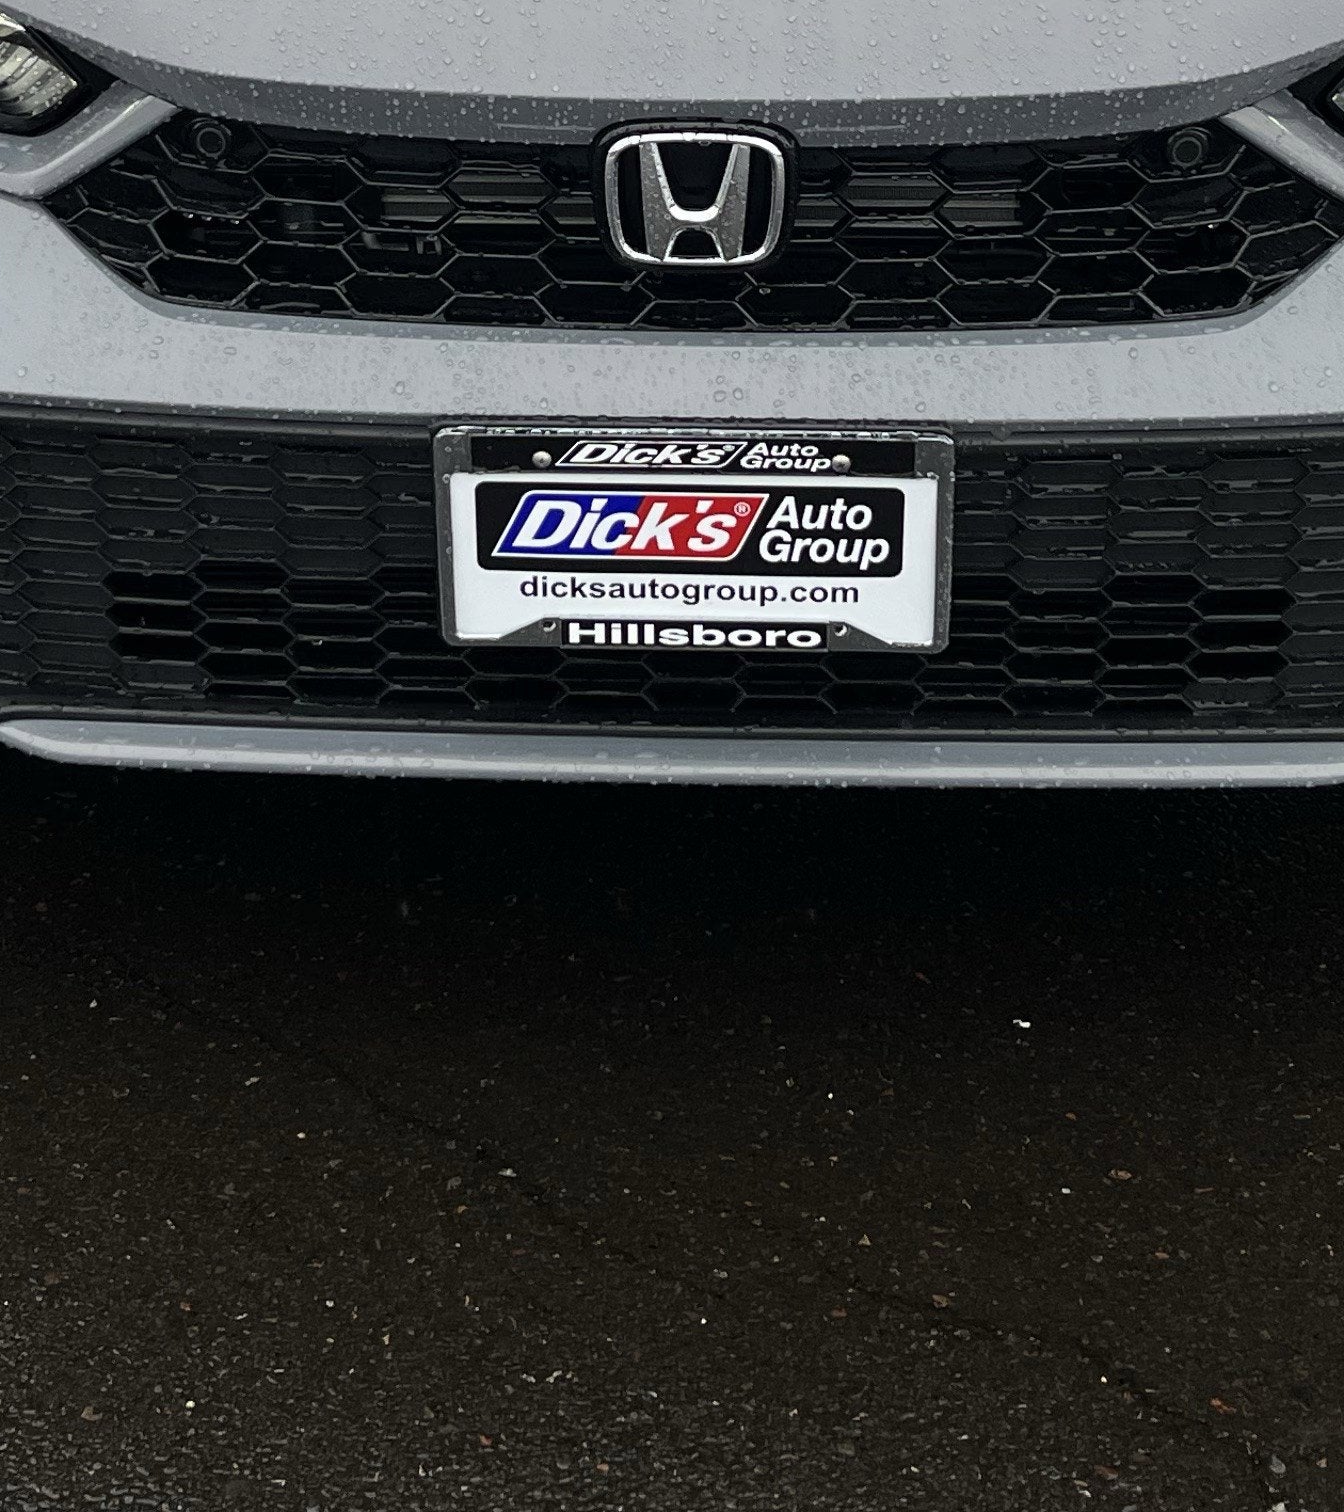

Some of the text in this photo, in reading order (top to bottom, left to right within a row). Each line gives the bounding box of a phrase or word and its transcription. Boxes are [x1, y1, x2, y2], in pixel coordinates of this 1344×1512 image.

[570, 443, 724, 465] Dick's
[746, 442, 819, 456] Auto
[739, 455, 832, 472] Group
[511, 498, 738, 551] Dick's
[766, 496, 873, 529] Auto
[759, 529, 891, 569] Group
[519, 576, 859, 606] dicksautogroup.com
[568, 622, 822, 648] Hillsboro
